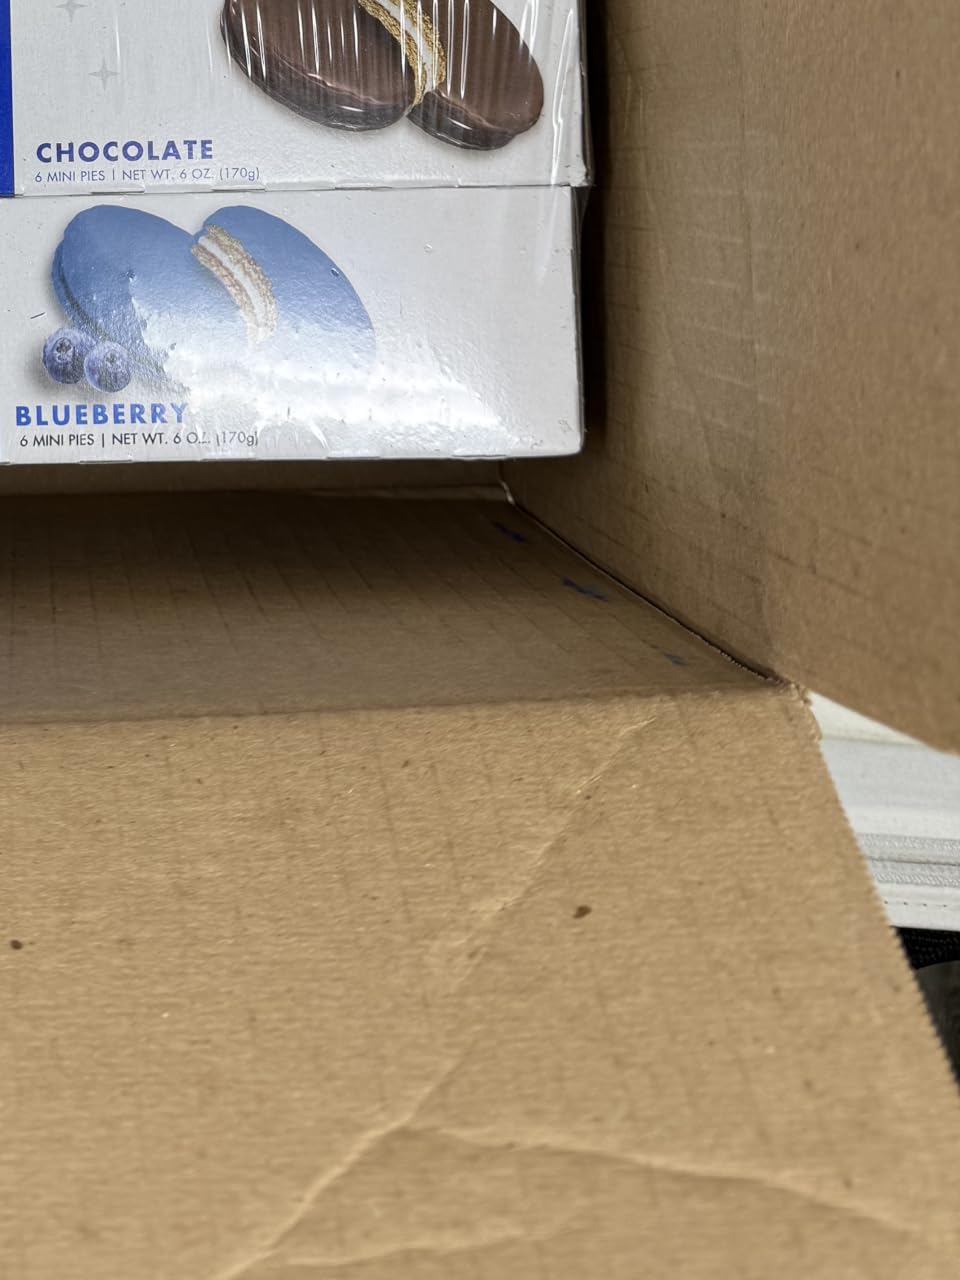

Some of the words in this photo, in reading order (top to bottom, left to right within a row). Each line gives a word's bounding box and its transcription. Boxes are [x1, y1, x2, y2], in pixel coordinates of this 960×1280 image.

[36, 139, 213, 163] CHOCOLATE
[35, 171, 42, 183] 6
[47, 171, 76, 182] MINI
[81, 170, 105, 181] PIES
[123, 169, 145, 181] NET
[150, 169, 174, 180] WT.
[180, 168, 187, 179] 6
[192, 168, 214, 179] OZ.
[219, 166, 259, 181] (170g)
[16, 402, 188, 426] BLUEBERRY
[20, 436, 27, 447] 6
[33, 435, 64, 447] MINI
[69, 435, 94, 446] PIES
[112, 433, 137, 446] NET
[142, 433, 167, 444] WT.
[173, 432, 181, 444] 6
